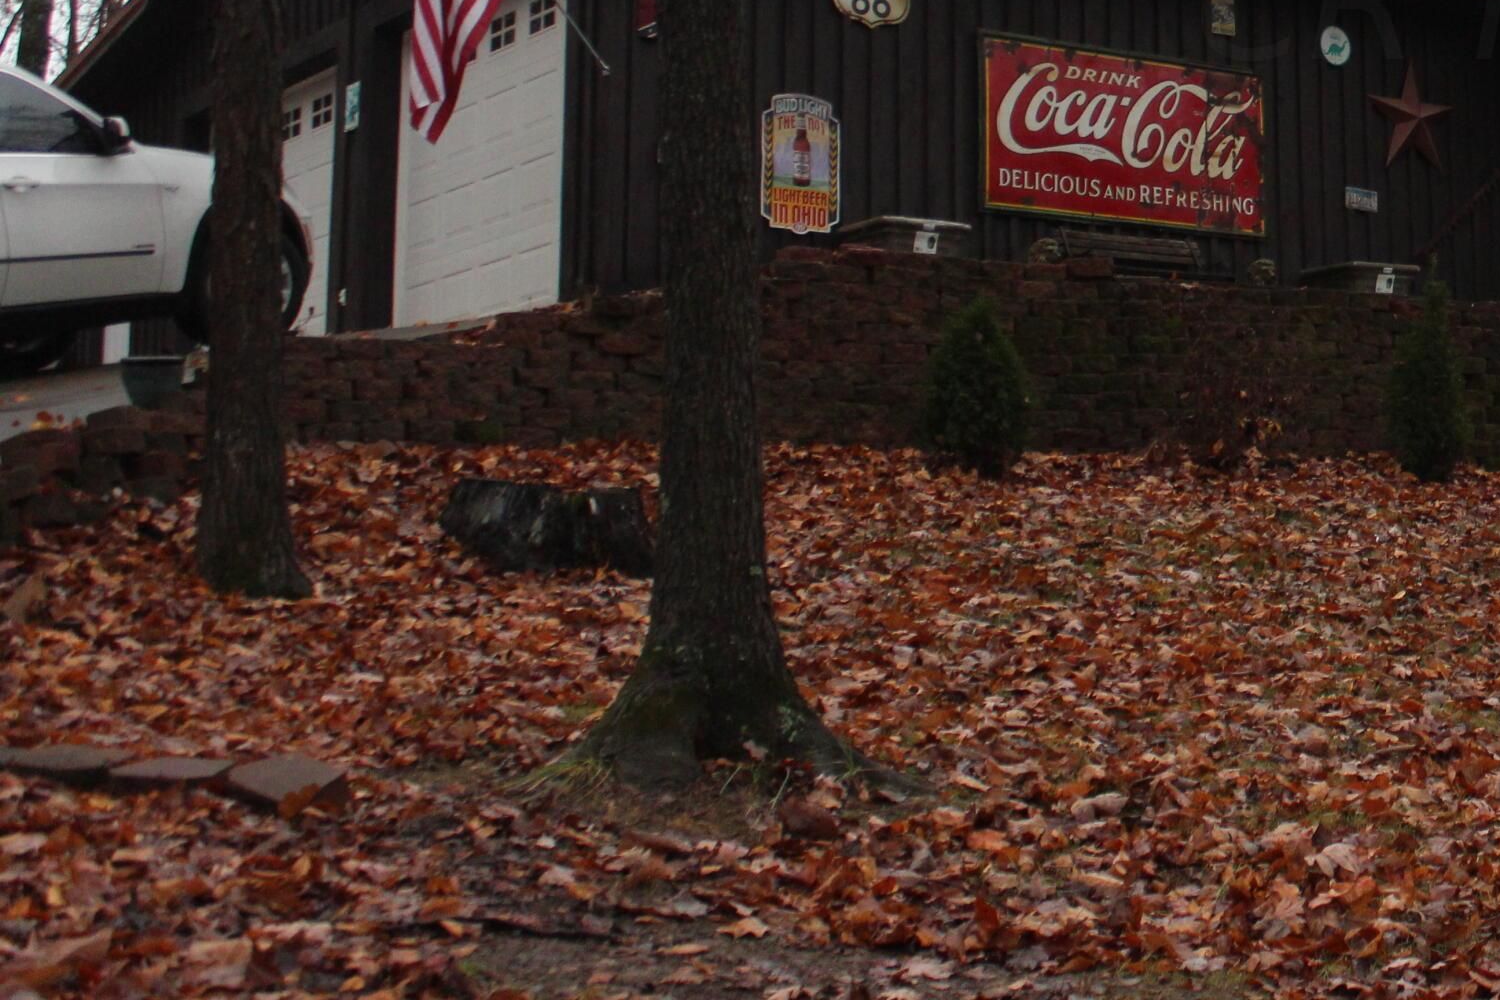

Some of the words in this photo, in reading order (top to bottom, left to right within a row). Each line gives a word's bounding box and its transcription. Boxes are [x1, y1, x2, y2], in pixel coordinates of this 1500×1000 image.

[1064, 65, 1143, 89] DRINK
[775, 98, 798, 113] BUD
[799, 98, 829, 120] LIGHT
[776, 115, 796, 130] THE
[996, 62, 1255, 181] Coca-Cola
[773, 187, 802, 204] LIGHT
[802, 190, 828, 207] BEER
[998, 167, 1101, 198] DELICIOUS
[1103, 184, 1136, 202] AND
[1139, 186, 1255, 216] REFRESHING
[773, 202, 789, 224] IN
[791, 204, 827, 228] OHIO
